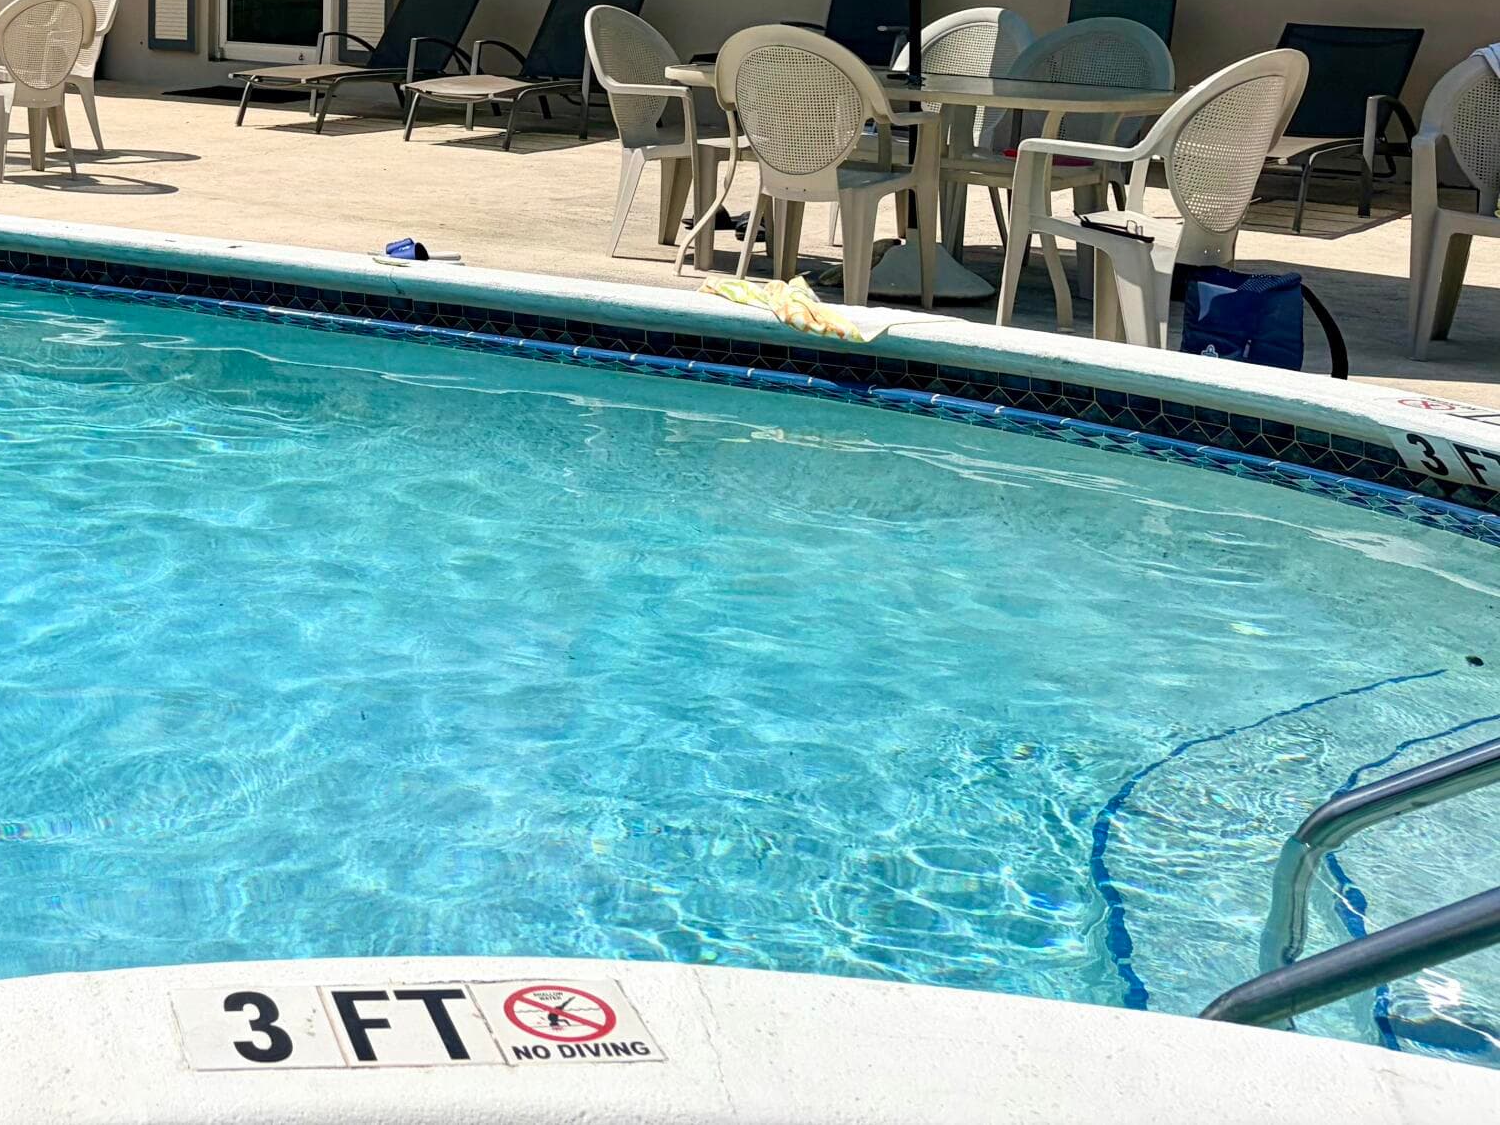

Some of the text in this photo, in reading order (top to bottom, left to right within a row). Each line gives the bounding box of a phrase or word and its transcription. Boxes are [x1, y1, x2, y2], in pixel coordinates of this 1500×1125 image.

[1406, 433, 1449, 476] 3
[222, 988, 472, 1063] 3 FT
[512, 1041, 651, 1060] NO DIVING
